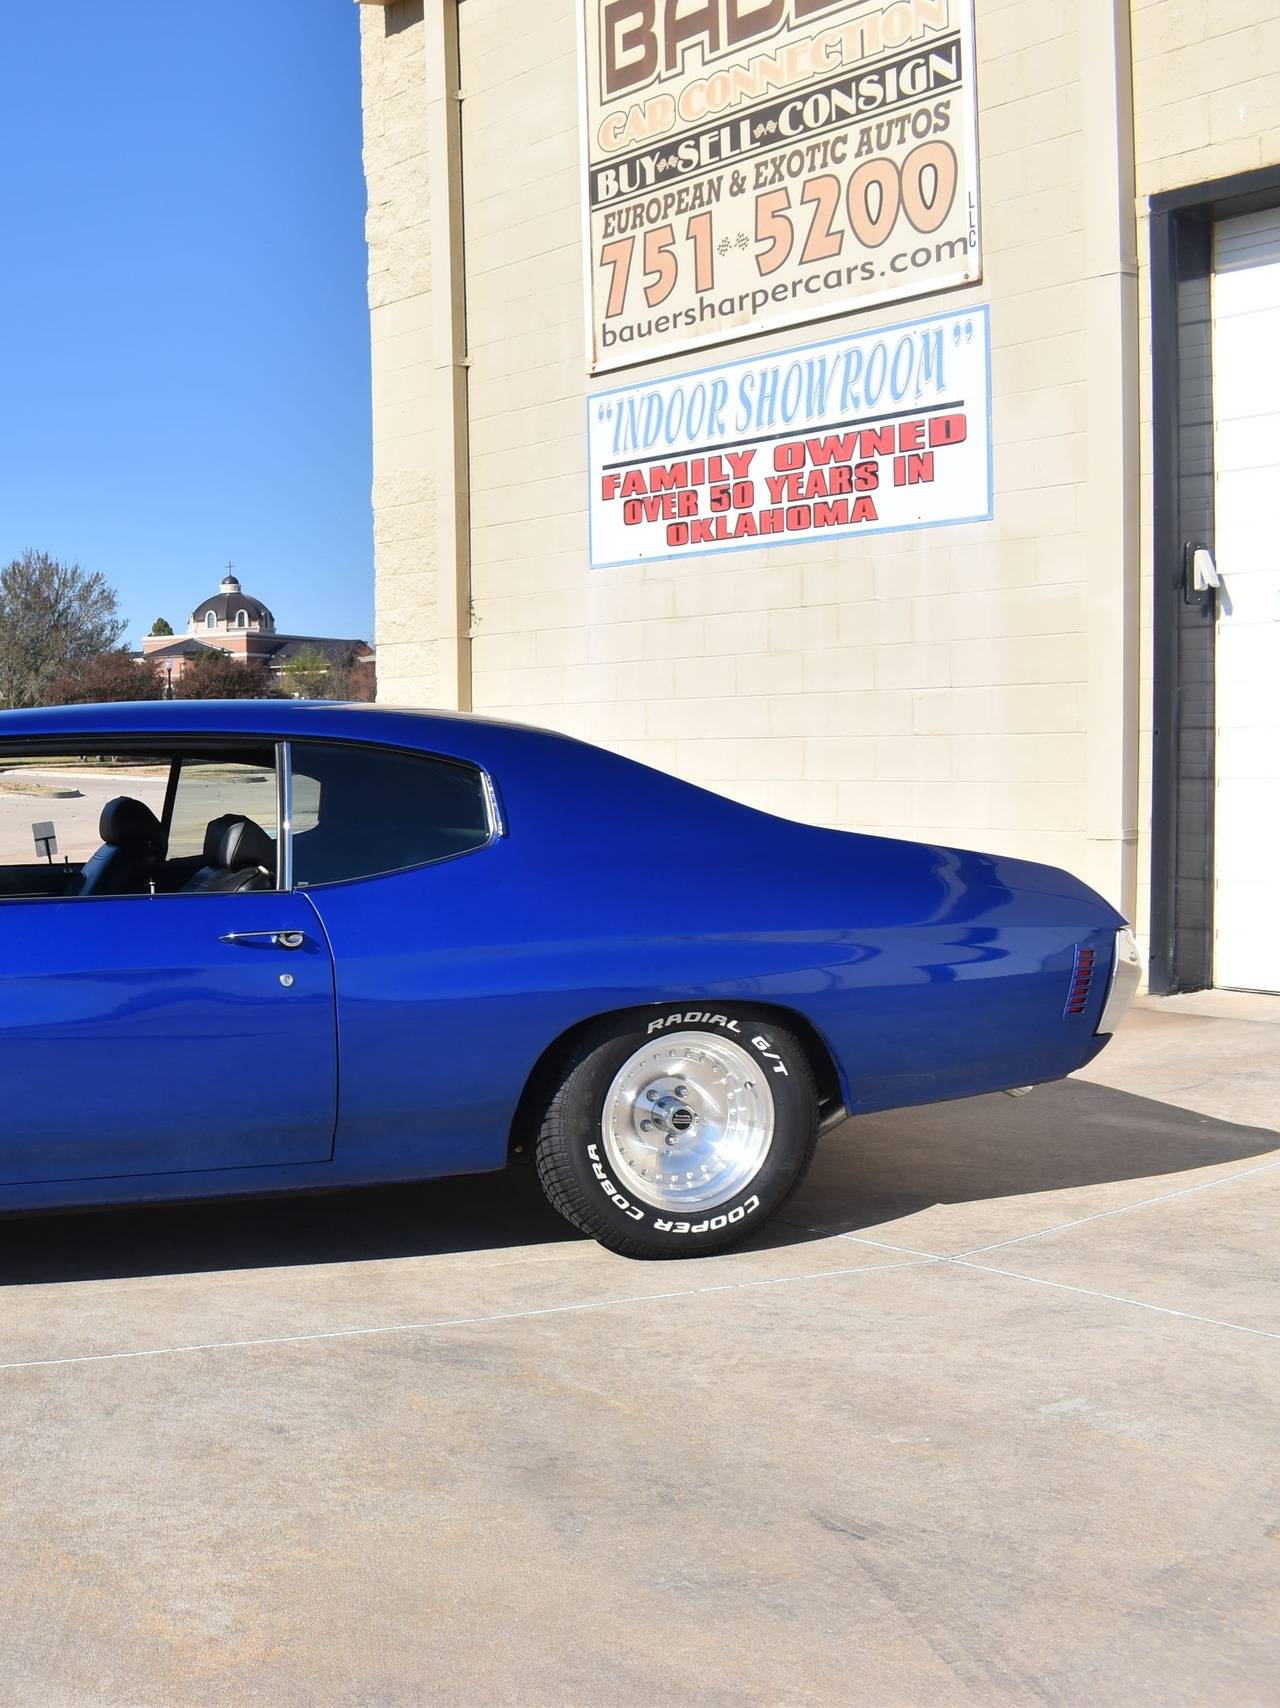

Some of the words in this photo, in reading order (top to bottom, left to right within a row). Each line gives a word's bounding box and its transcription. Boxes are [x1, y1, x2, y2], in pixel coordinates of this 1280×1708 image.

[598, 92, 678, 152] CAR
[677, 0, 950, 123] CONNECTION
[597, 150, 660, 201] BUY
[676, 120, 761, 173] SELL
[777, 45, 958, 138] CONSIGN
[602, 169, 724, 240] EUROPEAN
[728, 169, 748, 198] &
[752, 134, 849, 191] EXOTIC
[854, 100, 951, 159] AUTOS
[600, 210, 716, 320] 751
[754, 139, 959, 277] 5200
[601, 234, 969, 348] bauersharpercars.com
[601, 448, 758, 502] FAMILY
[773, 413, 968, 473] OWNED
[623, 489, 699, 526] OVER
[709, 480, 755, 513] 50
[766, 460, 880, 504] YEARS
[893, 451, 935, 488] IN
[666, 495, 879, 547] OKLAHOMA
[646, 1011, 742, 1035] RADIAL
[751, 1035, 790, 1077] G/T
[586, 1143, 645, 1222] COBRA
[653, 1195, 761, 1234] COOPER
